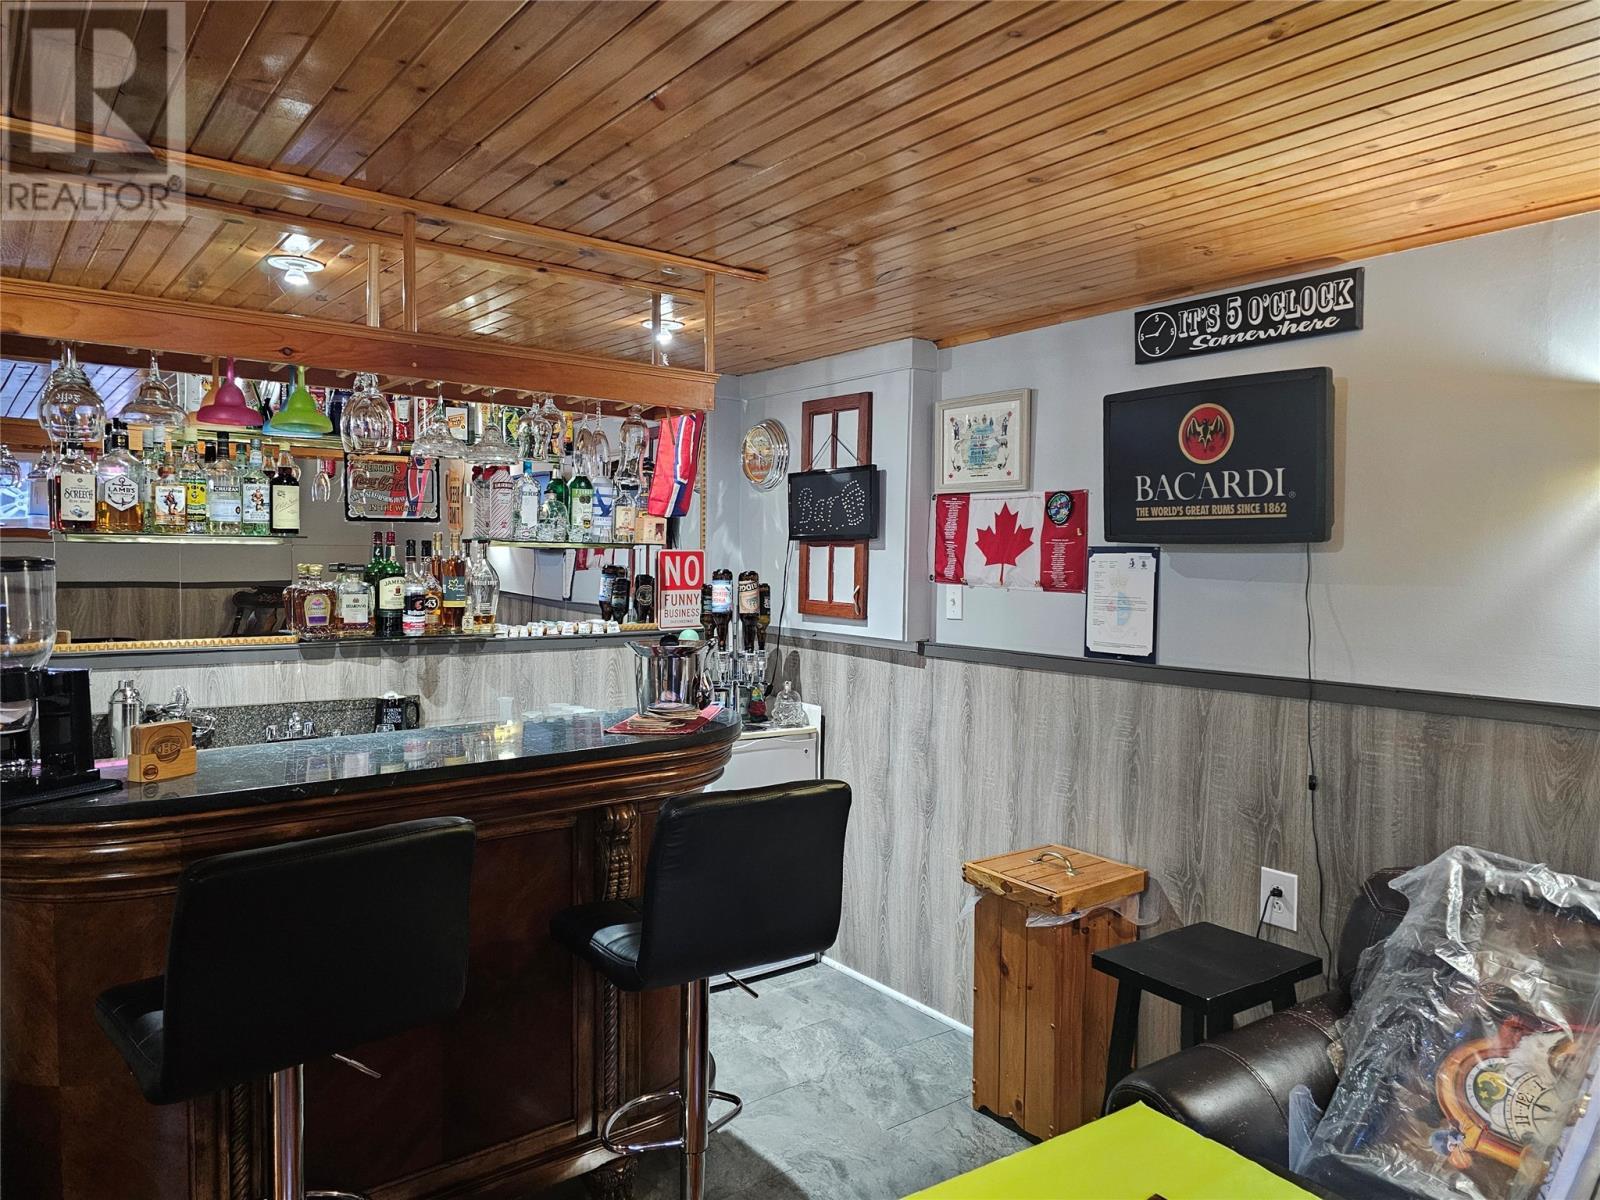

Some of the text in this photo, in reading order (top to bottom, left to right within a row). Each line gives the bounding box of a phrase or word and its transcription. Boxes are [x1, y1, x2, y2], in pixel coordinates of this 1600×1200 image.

[1178, 277, 1355, 338] IT'S 5 O'CLOCK
[1189, 315, 1341, 351] Somewhere
[1135, 468, 1286, 502] BACARDI
[1135, 502, 1287, 517] THE WORLD'S GREAT RUMS SINCE 1862
[664, 555, 700, 587] NO
[664, 593, 700, 607] FUNNY
[664, 608, 700, 619] BUSINESS
